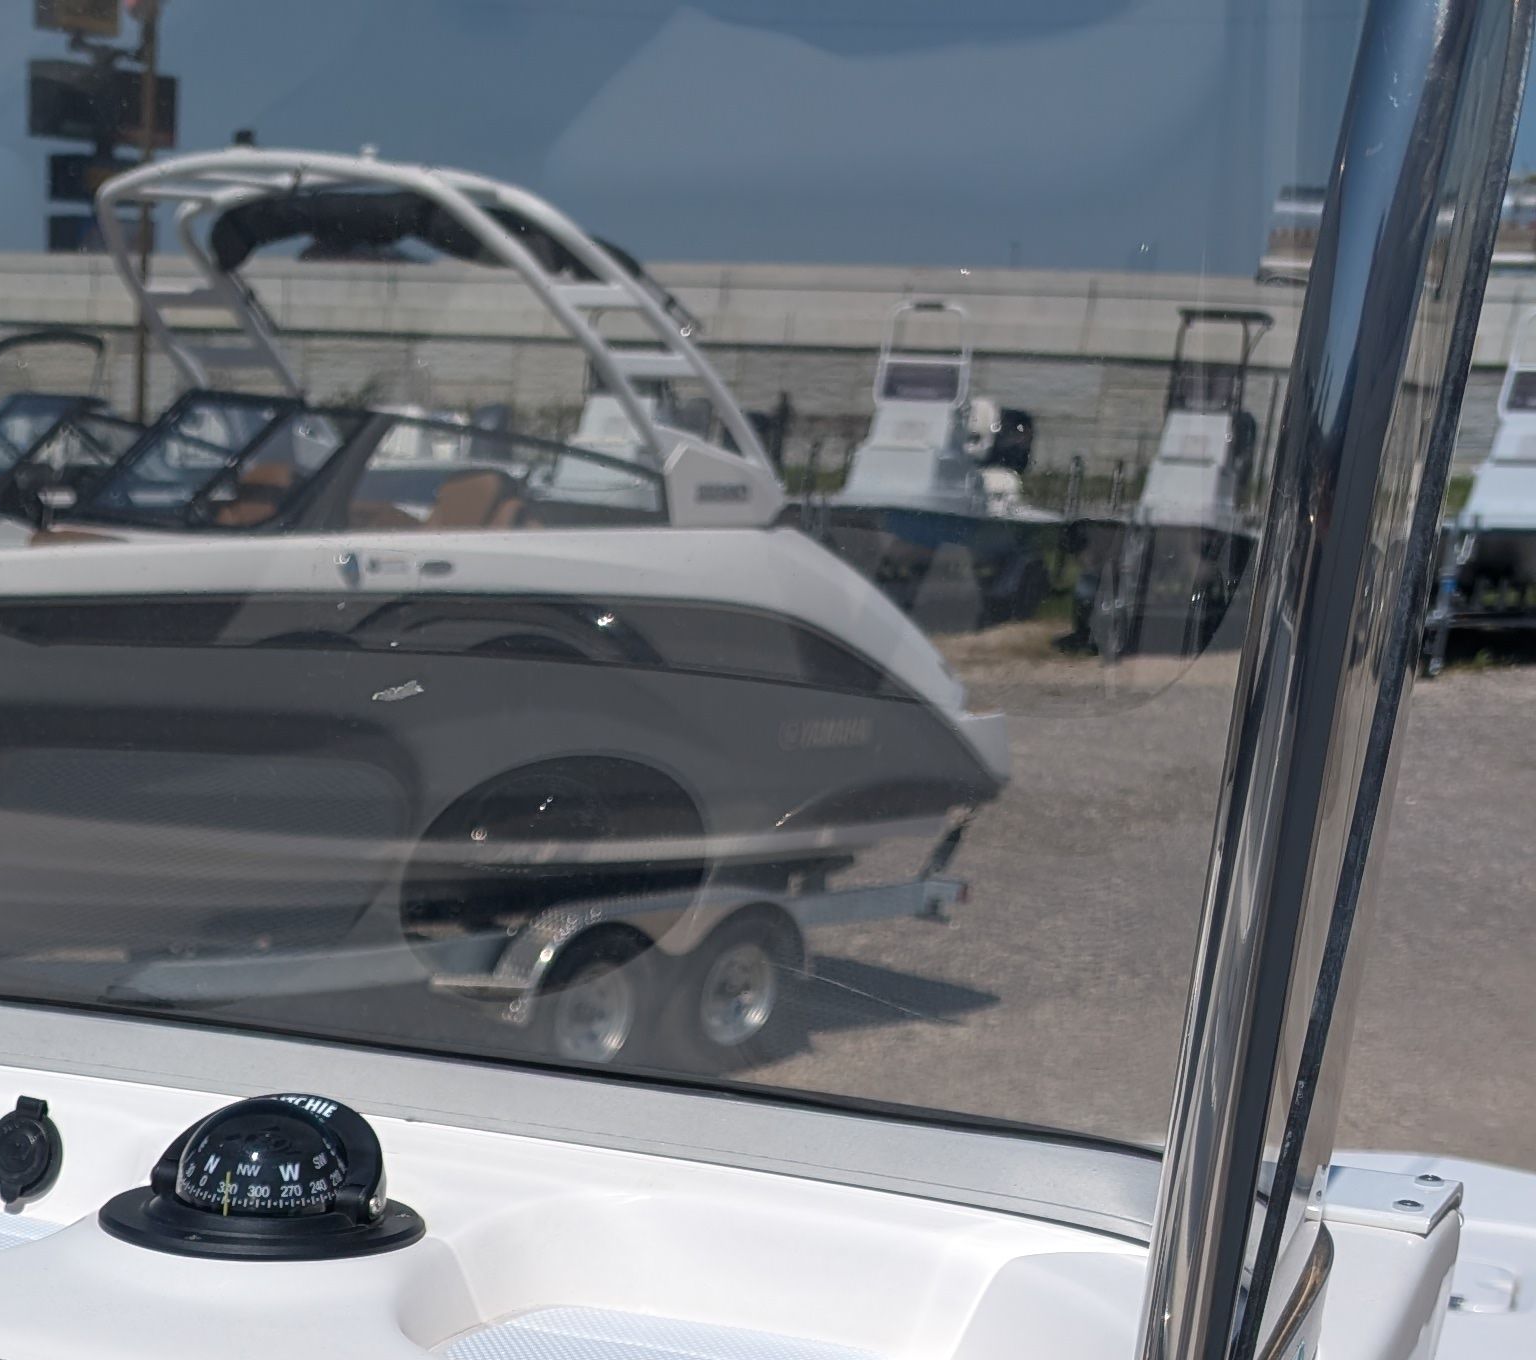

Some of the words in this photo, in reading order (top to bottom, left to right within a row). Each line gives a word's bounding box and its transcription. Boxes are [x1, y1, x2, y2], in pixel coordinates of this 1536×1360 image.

[203, 1154, 221, 1175] N
[236, 1163, 261, 1177] NW
[278, 1162, 300, 1182] W
[247, 1185, 271, 1198] 300
[280, 1185, 303, 1198] 270
